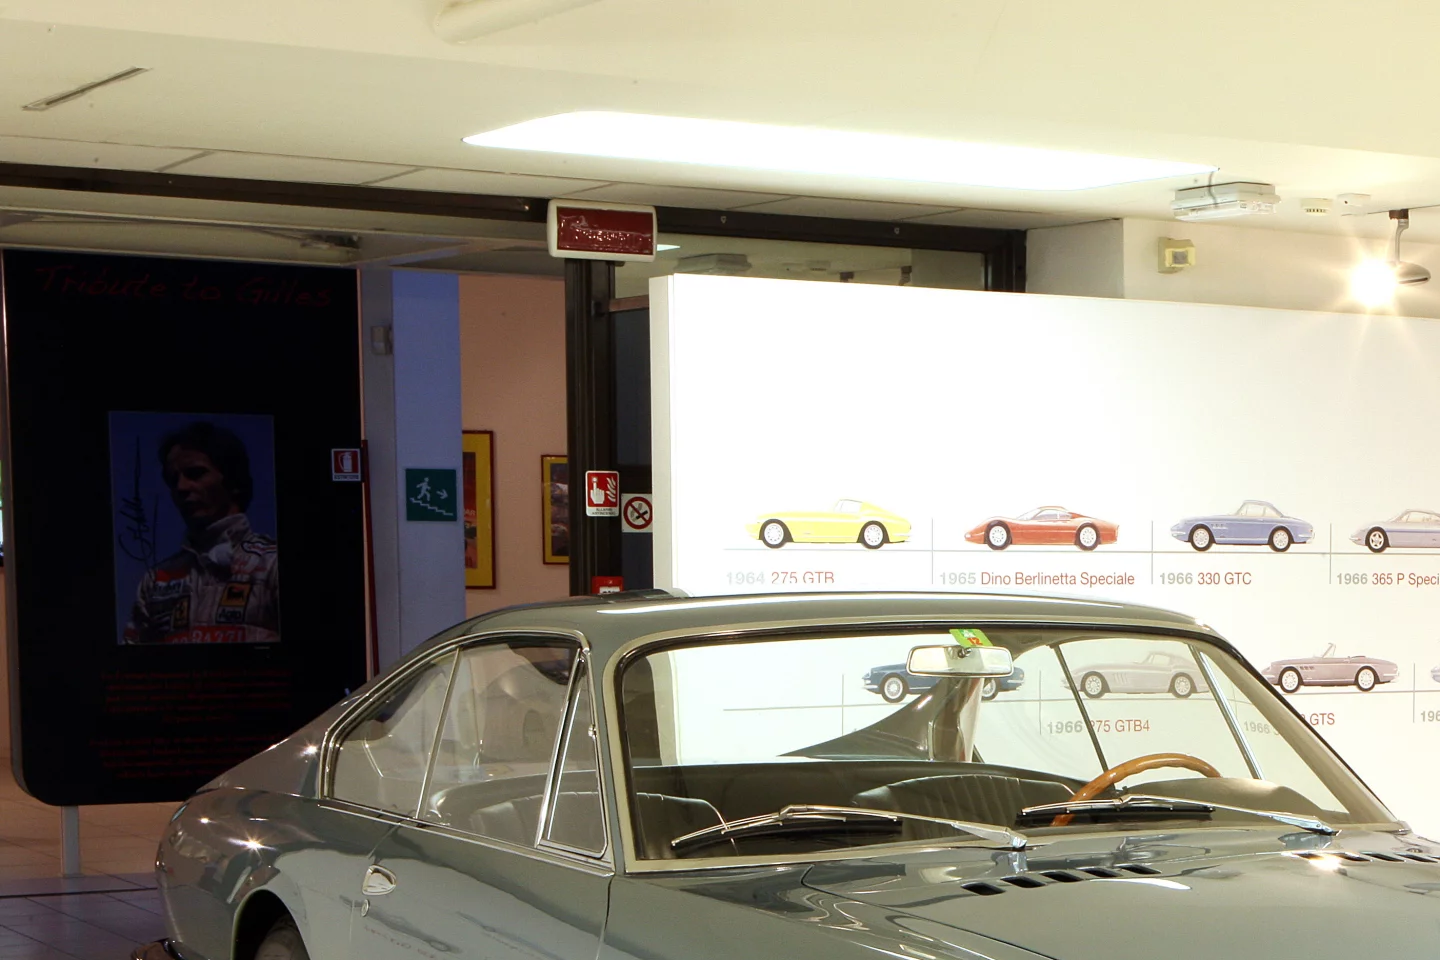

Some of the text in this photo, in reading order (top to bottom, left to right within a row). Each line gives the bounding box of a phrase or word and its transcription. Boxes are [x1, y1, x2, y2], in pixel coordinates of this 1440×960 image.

[726, 571, 766, 585] 1964
[771, 571, 798, 584] 275
[940, 572, 1135, 588] 1965 Dino Berlinetta Speciale
[1160, 572, 1251, 585] 1966 330 GTC
[1337, 573, 1368, 585] 1966
[1372, 573, 1393, 585] 365
[1397, 573, 1404, 584] P
[1310, 713, 1335, 725] GTS
[1047, 721, 1083, 734] 1966
[1115, 720, 1150, 733] GTB4
[1244, 721, 1270, 735] 1966
